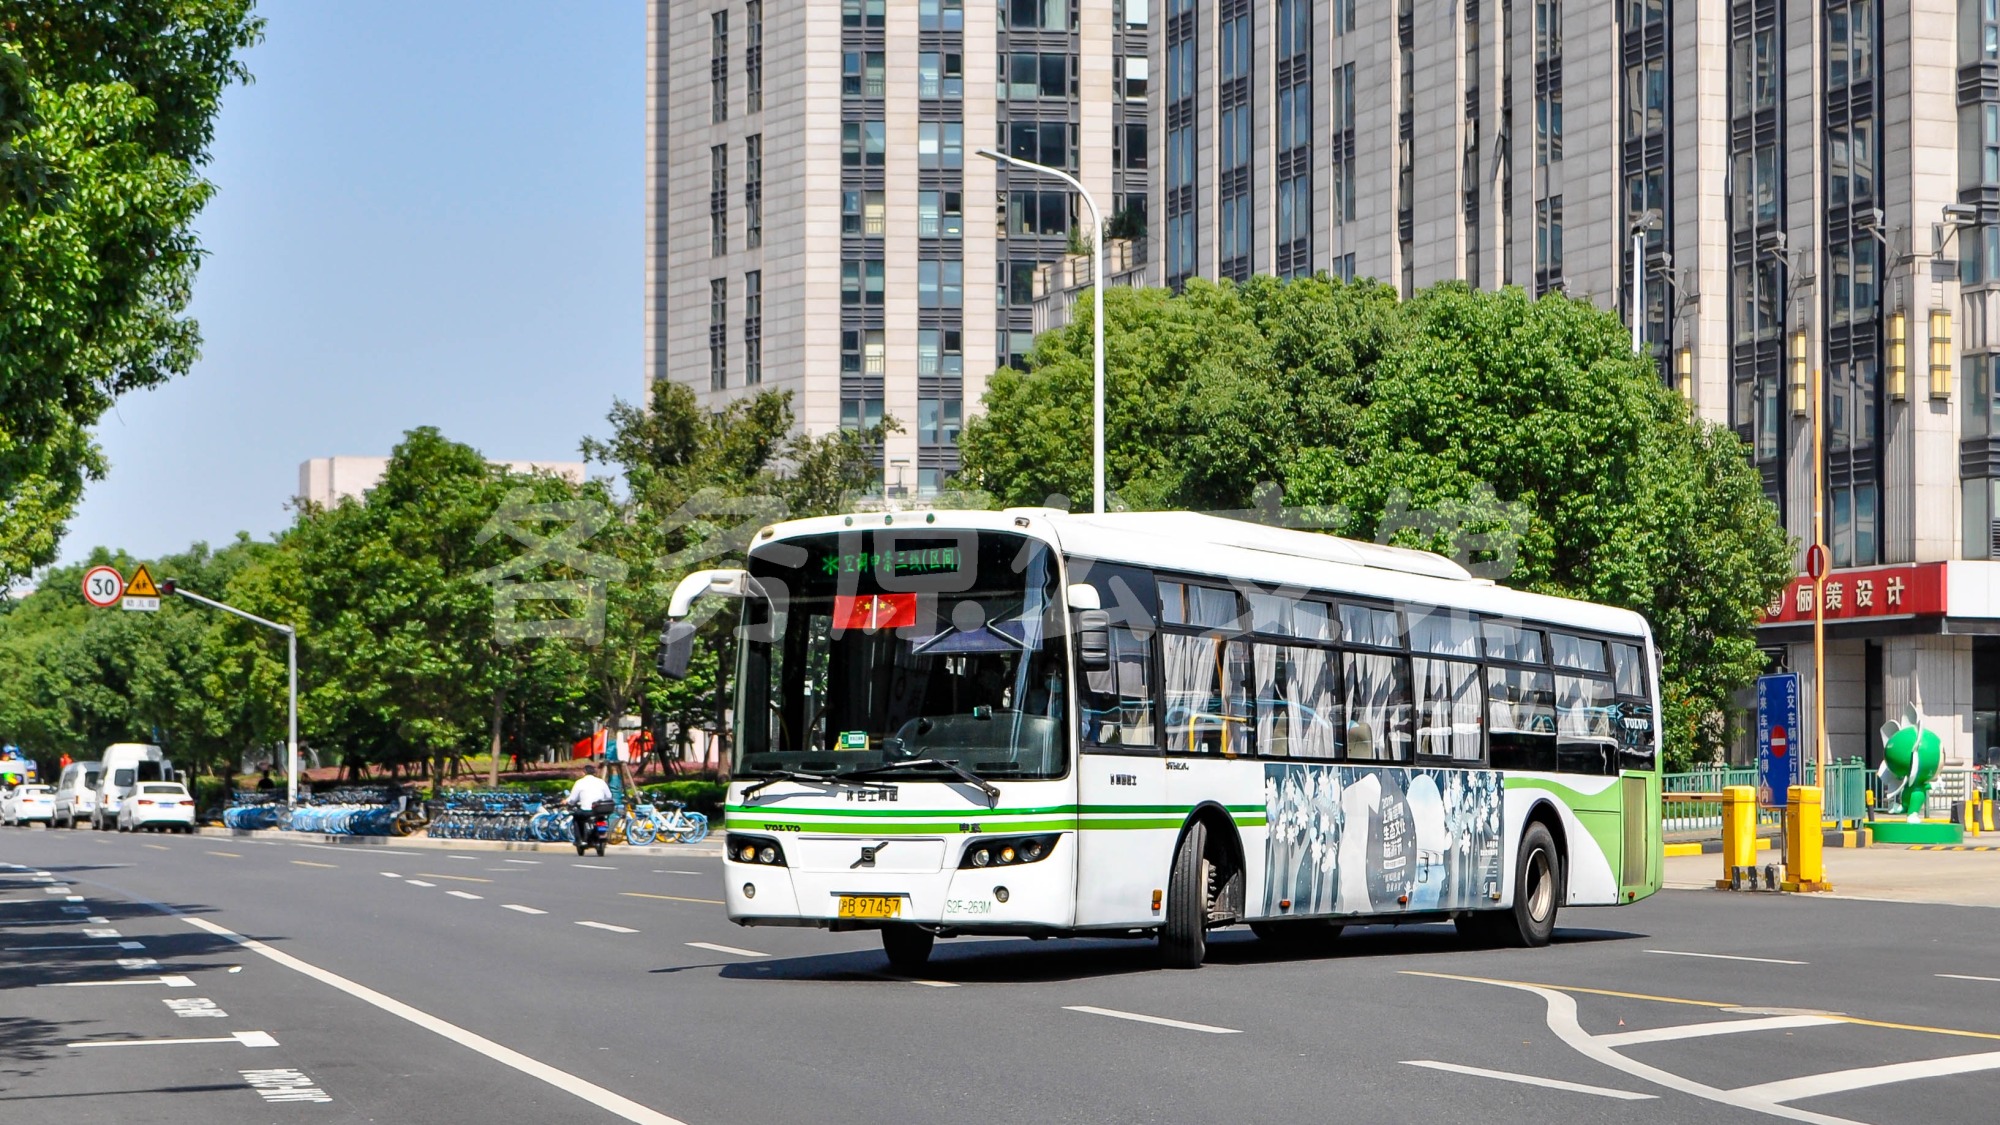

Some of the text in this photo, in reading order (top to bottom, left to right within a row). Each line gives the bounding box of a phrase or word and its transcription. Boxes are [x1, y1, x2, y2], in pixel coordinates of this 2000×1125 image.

[92, 579, 114, 596] 30
[1796, 576, 1906, 612] 俪策设计
[1624, 717, 1649, 730] VOLVO
[1786, 679, 1798, 786] 公交车辆出行通
[1760, 681, 1769, 803] 外来车辆不得入内
[764, 823, 802, 832] VOLVO
